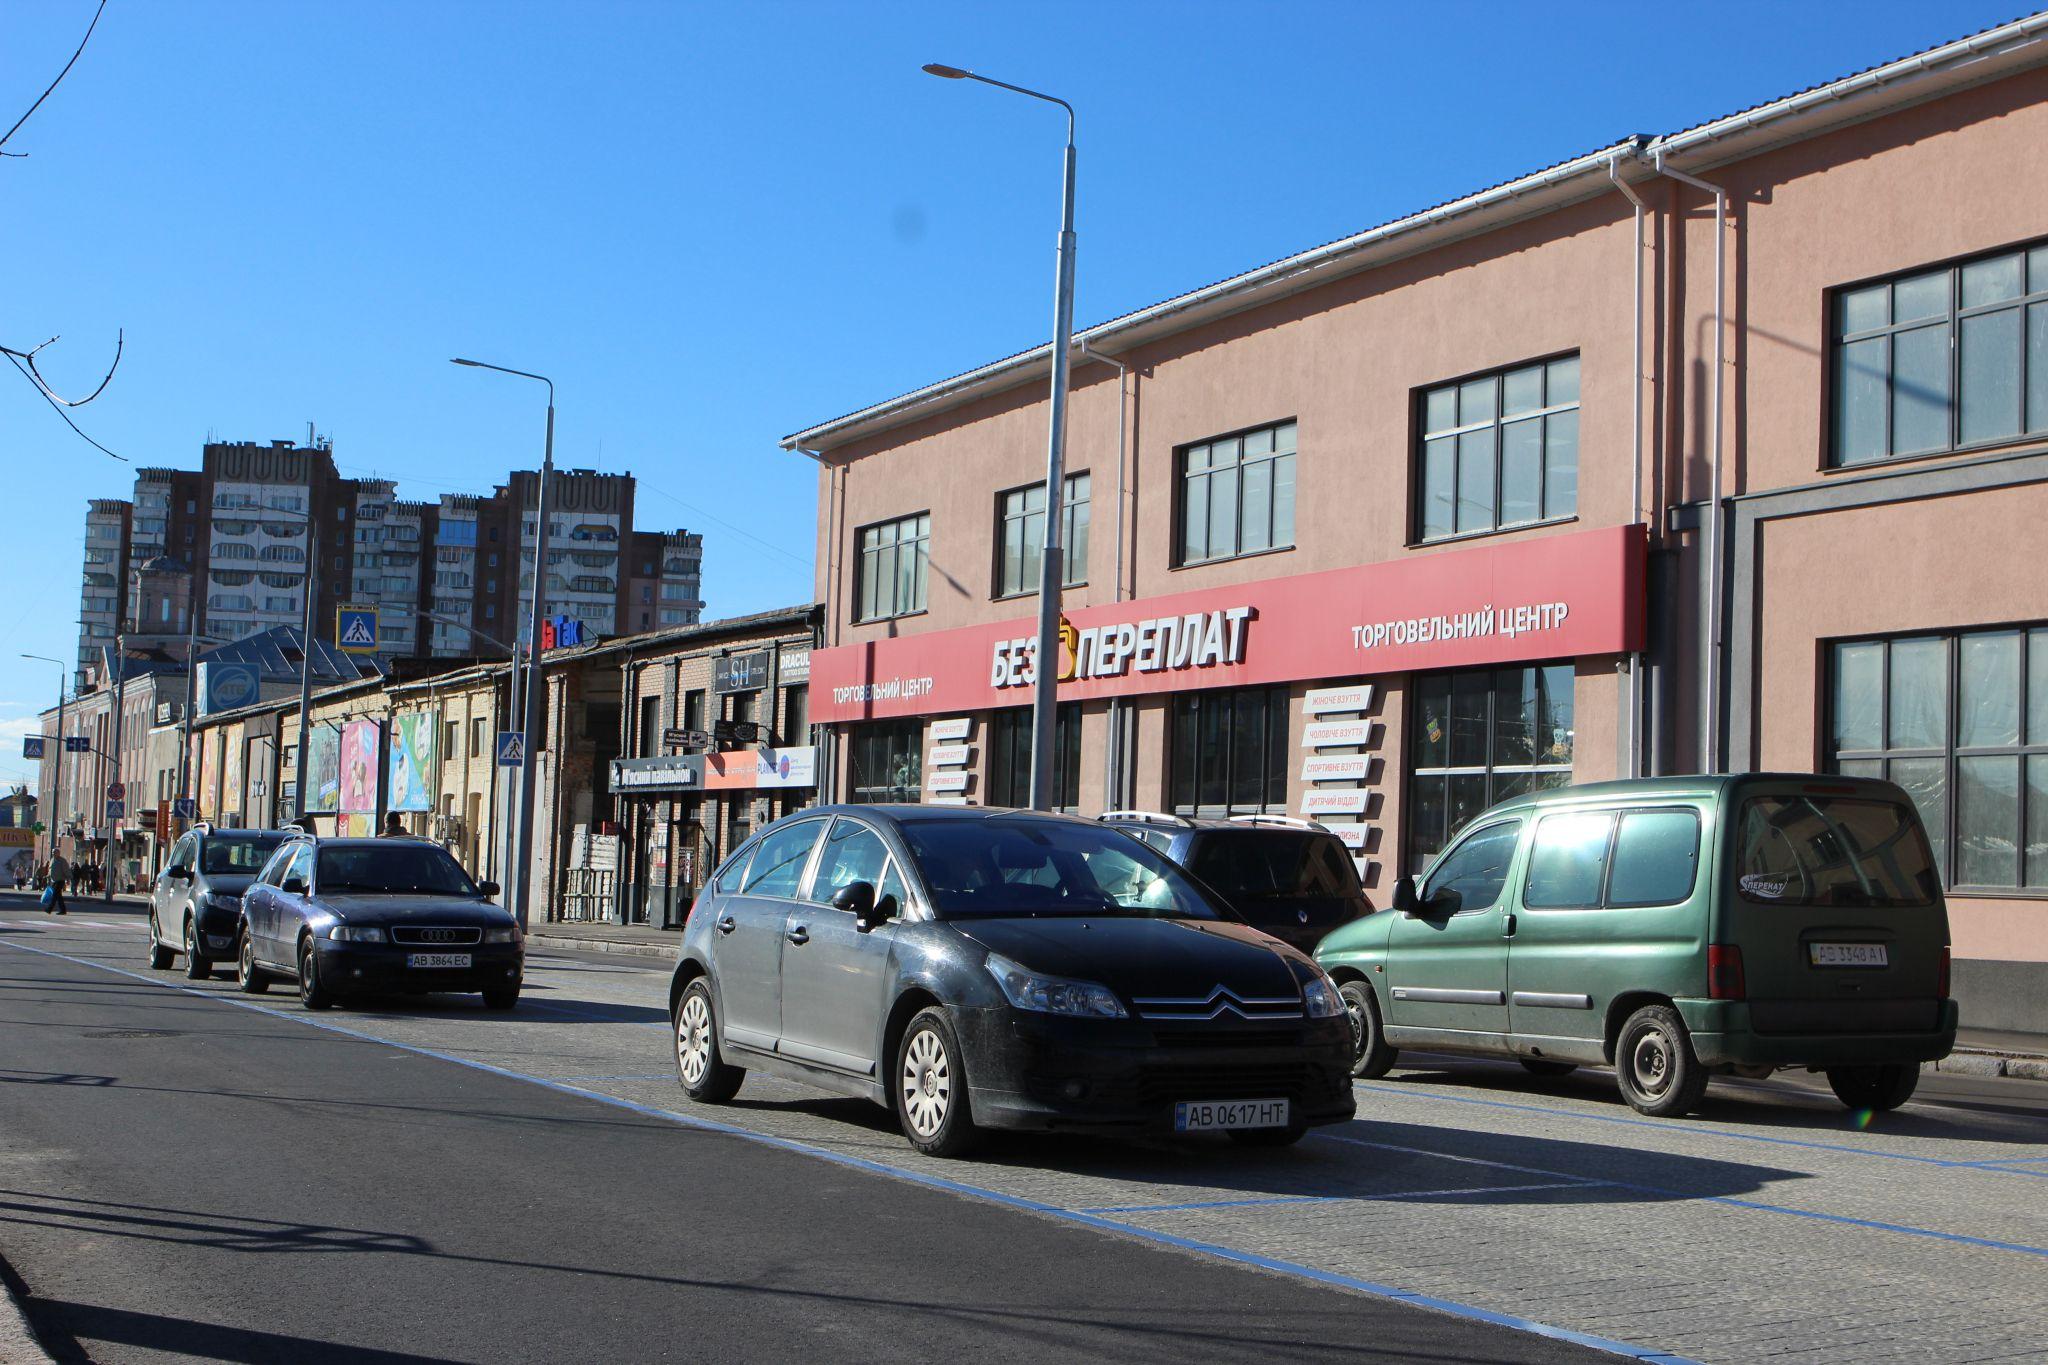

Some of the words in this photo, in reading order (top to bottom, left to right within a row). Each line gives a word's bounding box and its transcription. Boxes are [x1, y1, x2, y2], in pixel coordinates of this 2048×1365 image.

[1352, 604, 1494, 648] ТОРГОВЕЛЬНИЙ
[1500, 602, 1568, 638] ЦЕНТР
[991, 636, 1039, 687] БЕЗ
[1075, 606, 1253, 678] ПЕРЕПЛАТ
[731, 659, 749, 686] SH
[833, 677, 900, 704] ТОРГОВЕЛЬНИЙ
[901, 677, 933, 700] ЦЕНТР
[1312, 695, 1337, 706] ЖІНОЧЕ
[1337, 694, 1361, 704] ВЗУТТЯ
[1310, 730, 1340, 739] ЧОЛОВІЧЕ
[1340, 728, 1363, 737] ВЗУТТЯ
[1307, 763, 1340, 772] СПОРТИВНЕ
[1340, 762, 1363, 771] ВЗУТТЯ
[1308, 796, 1337, 808] ДИТЯЧИЙ
[1338, 797, 1359, 806] ВІДДІЛ
[1748, 881, 1783, 890] ПЕРЕКАТ
[414, 956, 428, 966] AB
[430, 956, 452, 966] 3864
[455, 955, 468, 965] EC
[1189, 1106, 1213, 1126] AB
[1217, 1105, 1256, 1125] 0617
[1261, 1103, 1283, 1122] HT
